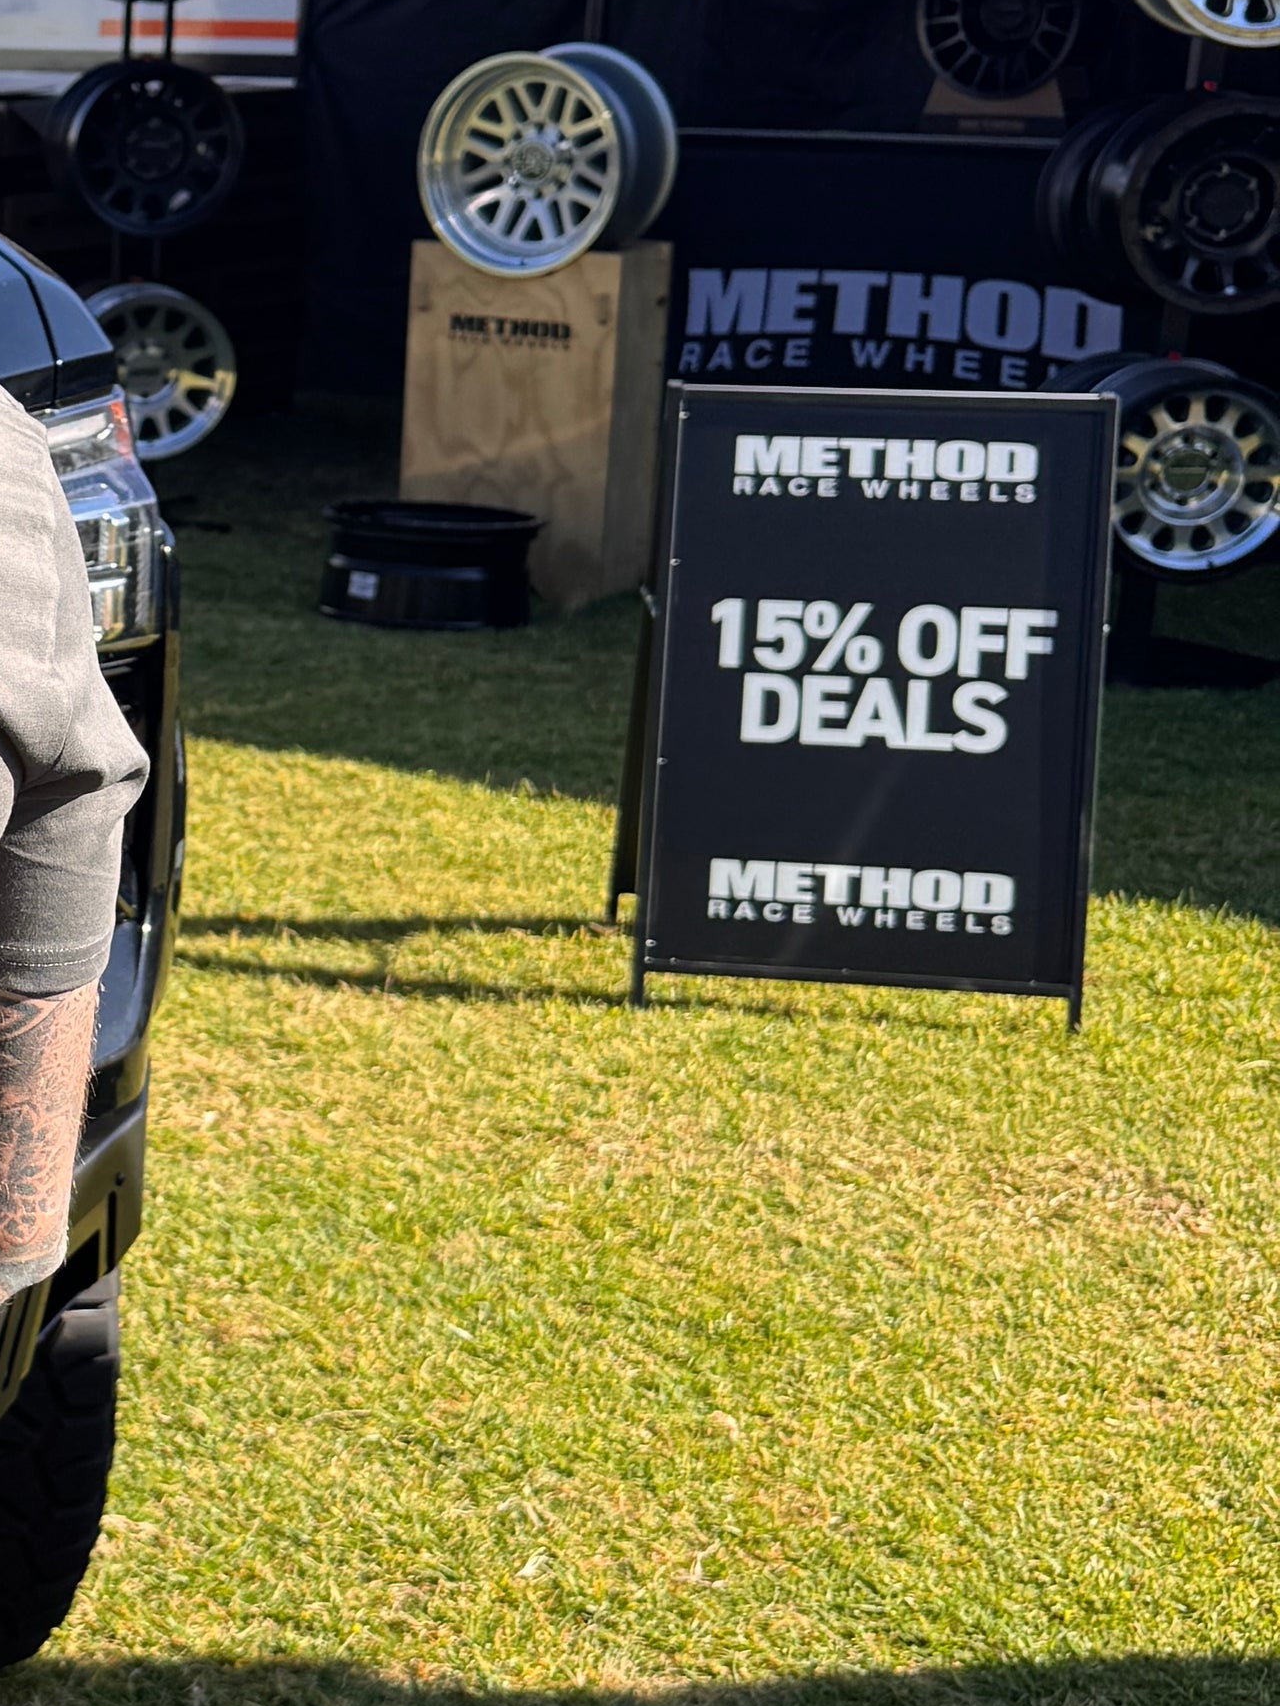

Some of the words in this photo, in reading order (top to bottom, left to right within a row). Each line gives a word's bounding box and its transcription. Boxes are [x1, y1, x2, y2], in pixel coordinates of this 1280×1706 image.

[685, 269, 1124, 362] METHOD
[678, 338, 812, 371] RACE
[734, 434, 1039, 483] METHOD
[732, 475, 838, 498] RACE
[860, 479, 1037, 504] WHEELS
[711, 597, 883, 674] 15%
[897, 604, 1059, 680] OFF
[740, 672, 1009, 754] DEALS
[708, 858, 1016, 914] METHOD
[707, 898, 814, 924] RACE
[836, 906, 1013, 936] WHEELS
